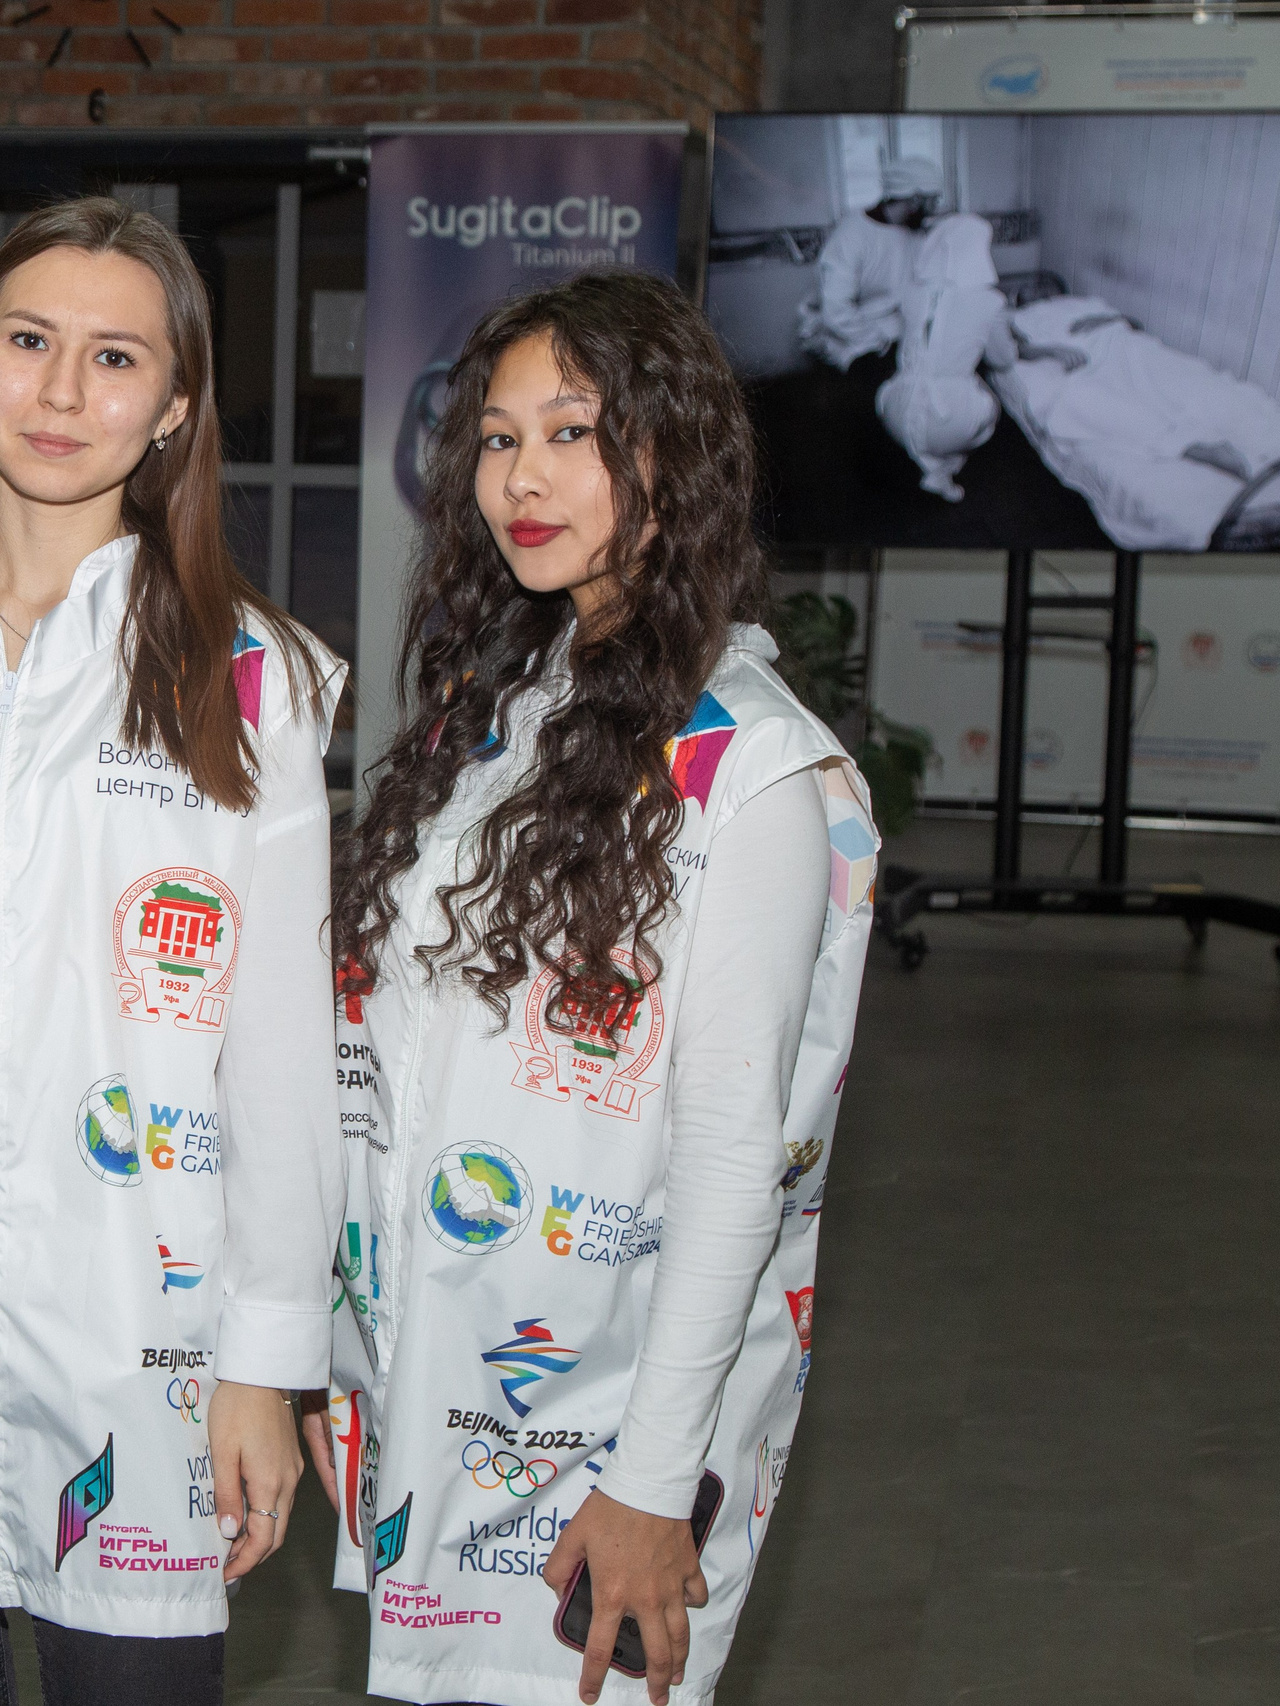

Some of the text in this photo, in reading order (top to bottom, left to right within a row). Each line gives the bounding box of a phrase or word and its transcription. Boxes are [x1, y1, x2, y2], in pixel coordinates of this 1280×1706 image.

[407, 196, 642, 248] SugitaClip
[511, 242, 616, 268] Titanium
[96, 777, 174, 809] центр
[158, 978, 190, 993] 1932
[571, 1057, 603, 1074] 1932
[446, 1408, 518, 1446] BEIJING
[99, 1523, 153, 1534] PHYGITAL
[99, 1535, 168, 1553] ИГРЫ
[99, 1554, 220, 1572] БУДУЩЕГО
[382, 1590, 442, 1611] ИГРЫ
[380, 1608, 503, 1629] БУДУЩЕГО
